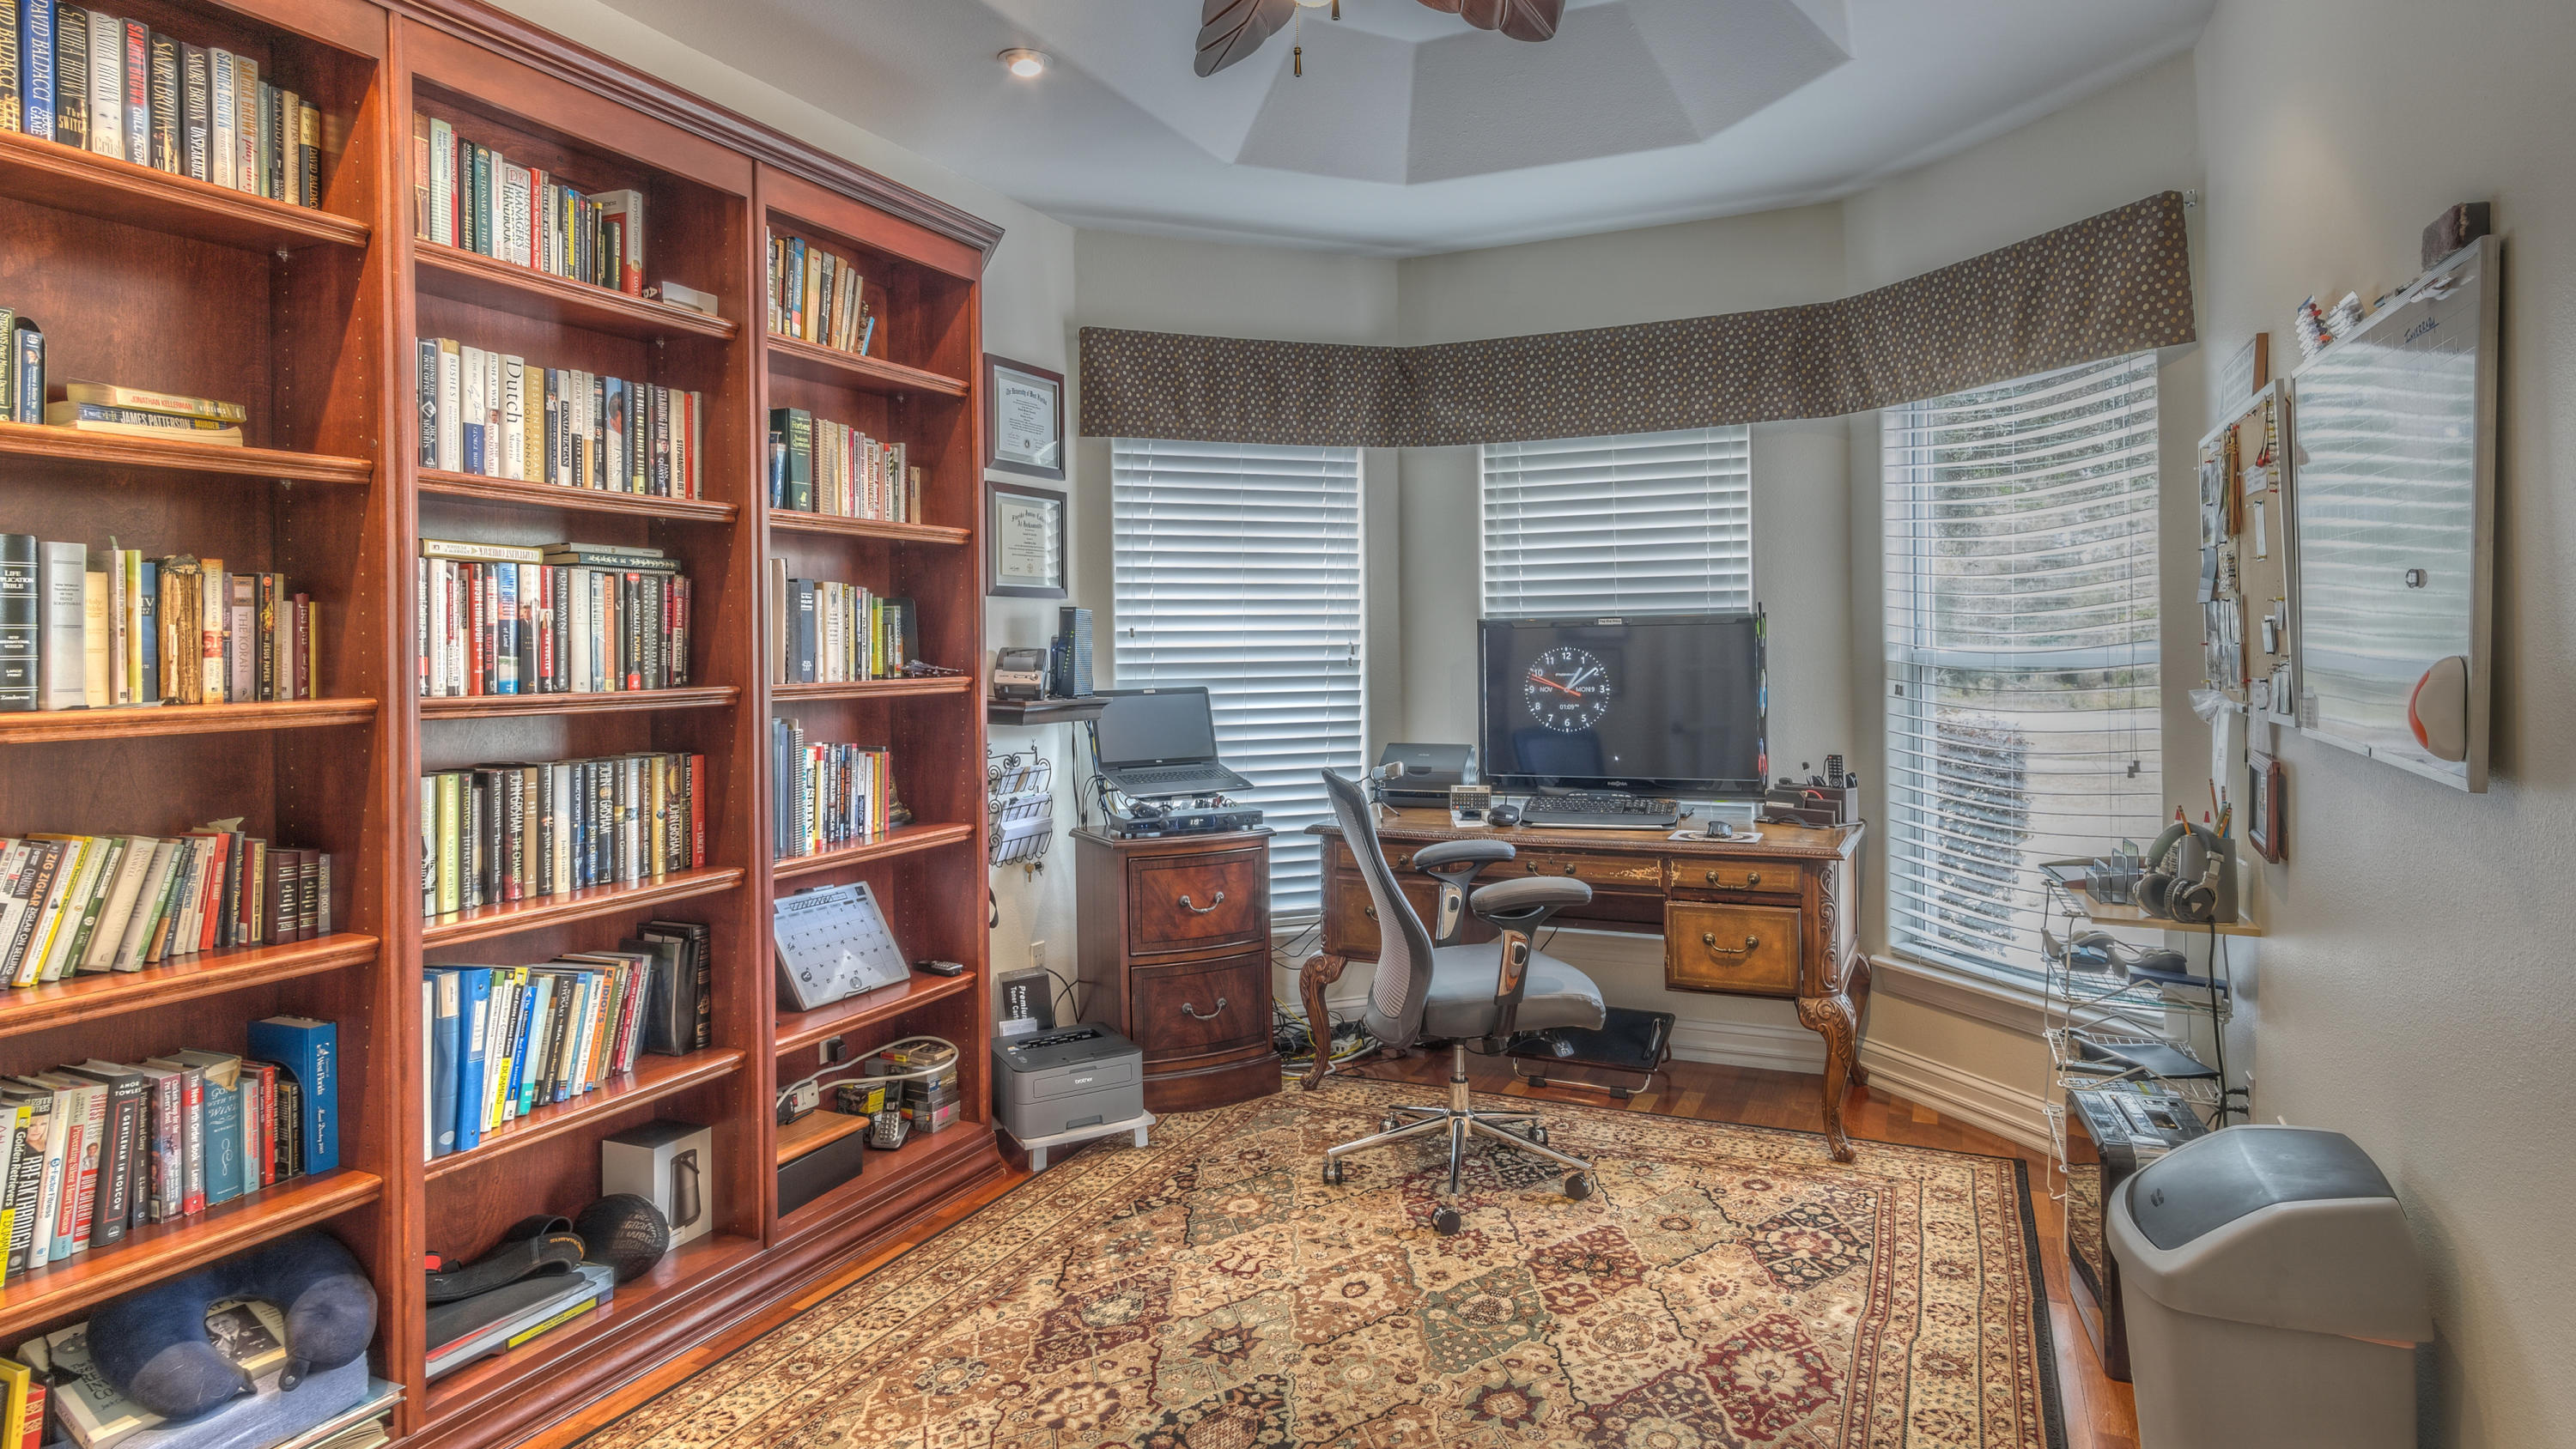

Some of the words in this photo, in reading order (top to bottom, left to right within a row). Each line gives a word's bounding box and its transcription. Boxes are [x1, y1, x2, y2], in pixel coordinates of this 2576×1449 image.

[31, 0, 49, 37] DAVID
[58, 8, 85, 57] SANDRA
[96, 17, 118, 62] SANDRA
[127, 23, 144, 68] SANDRA
[0, 29, 16, 90] BALDACCI
[32, 36, 51, 102] BALDACCI
[153, 39, 174, 87] SANDRA
[188, 52, 205, 88] SANDRA
[216, 52, 232, 92] SANDRA
[60, 57, 85, 99] BROWN
[97, 63, 118, 106] BROWN
[130, 67, 144, 105] BROWN
[240, 61, 255, 100] SANDRA
[132, 106, 143, 133] CHILL
[154, 81, 175, 131] BROWN
[189, 86, 206, 123] BROWN
[217, 88, 233, 131] BROWN
[240, 100, 256, 139] BROWN
[30, 106, 43, 136] GAME
[190, 126, 206, 180] UNSPEAKABLE
[309, 146, 318, 176] DAVID
[479, 165, 489, 217] DICTIONARY
[510, 170, 526, 183] DK
[481, 217, 488, 226] OF
[503, 185, 514, 243] HANDBOOK
[631, 195, 641, 225] Everyday
[491, 378, 496, 388] AT
[506, 361, 522, 423] Dutch
[131, 396, 161, 406] JONATHAN
[161, 399, 192, 410] KELLERMAN
[658, 390, 667, 420] STANDING
[120, 411, 147, 427] JAMES
[147, 413, 191, 429] PATTERSON
[659, 421, 668, 439] FIRM
[474, 581, 483, 602] RUSH
[502, 568, 514, 589] JIMMY
[502, 591, 514, 617] BUFFETT
[239, 612, 248, 633] THE
[239, 636, 249, 673] KORAN
[1562, 652, 1571, 660] 12
[1600, 685, 1605, 694] 3
[509, 775, 523, 796] JOHN
[599, 767, 611, 786] JOHN
[509, 797, 523, 834] GRISHAM
[600, 800, 612, 834] GRISHAM
[670, 803, 679, 822] JOHN
[513, 836, 522, 850] THE
[671, 825, 680, 856] GRISHAM
[43, 852, 58, 870] ZIG
[15, 868, 36, 895] CHARISMA
[28, 872, 51, 907] ZIGLAR
[21, 906, 39, 932] ZIGLAR
[17, 934, 29, 946] ON
[6, 946, 24, 975] SELLING
[558, 980, 569, 1018] KIYOSAKI
[597, 985, 611, 1023] IDIOT'S
[115, 1088, 141, 1096] TOWLES
[119, 1081, 140, 1089] AMOR
[496, 1065, 509, 1106] DUMMIES
[88, 1094, 107, 1121] STRESS
[11, 1131, 27, 1162] Golden
[68, 1126, 83, 1163] Preventing
[119, 1116, 130, 1160] GENTLEMAN
[6, 1163, 21, 1207] Retrievers
[65, 1164, 78, 1183] Silent
[81, 1173, 97, 1188] DON
[44, 1194, 57, 1219] Fitness
[63, 1184, 76, 1203] Heart
[113, 1175, 124, 1210] MOSCOW
[60, 1206, 73, 1234] Disease
